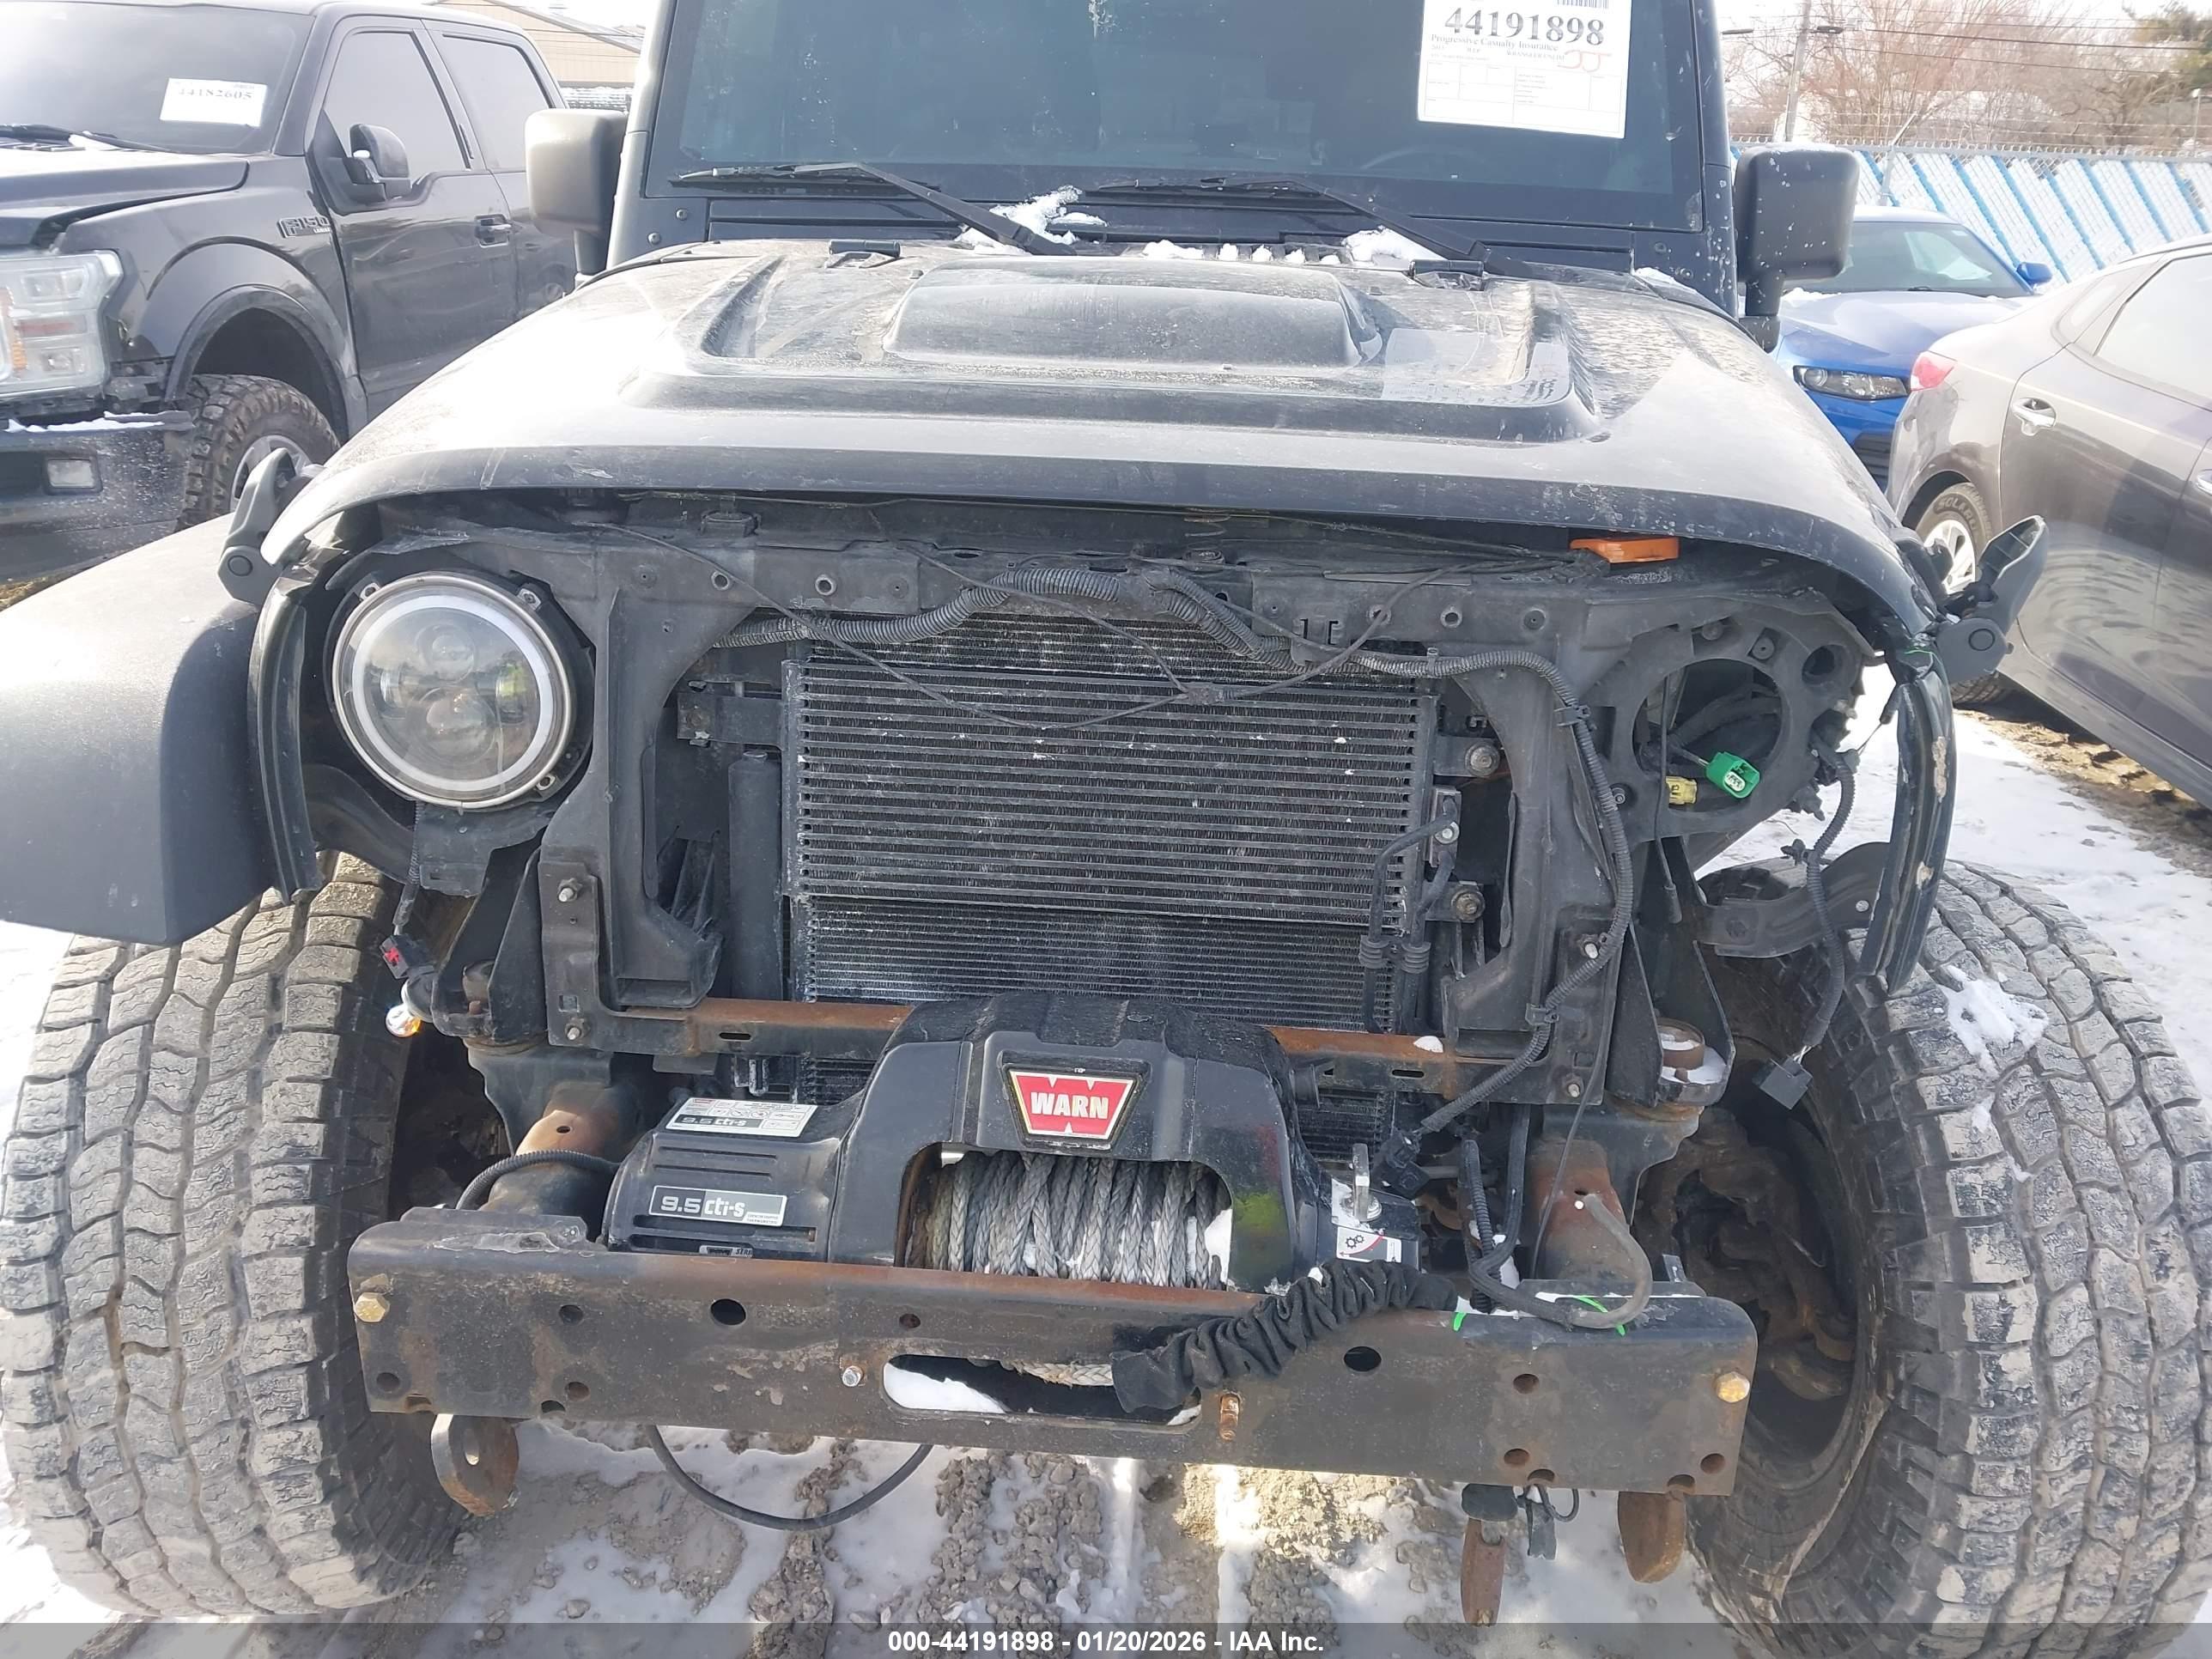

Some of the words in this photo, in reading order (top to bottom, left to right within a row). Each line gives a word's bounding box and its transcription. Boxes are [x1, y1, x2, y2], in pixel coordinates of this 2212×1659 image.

[1444, 7, 1604, 46] 44191898
[1431, 34, 1479, 46] Progressive
[1480, 38, 1516, 49] Casualty
[1518, 40, 1559, 52] Insurance
[1030, 1091, 1109, 1120] WARN
